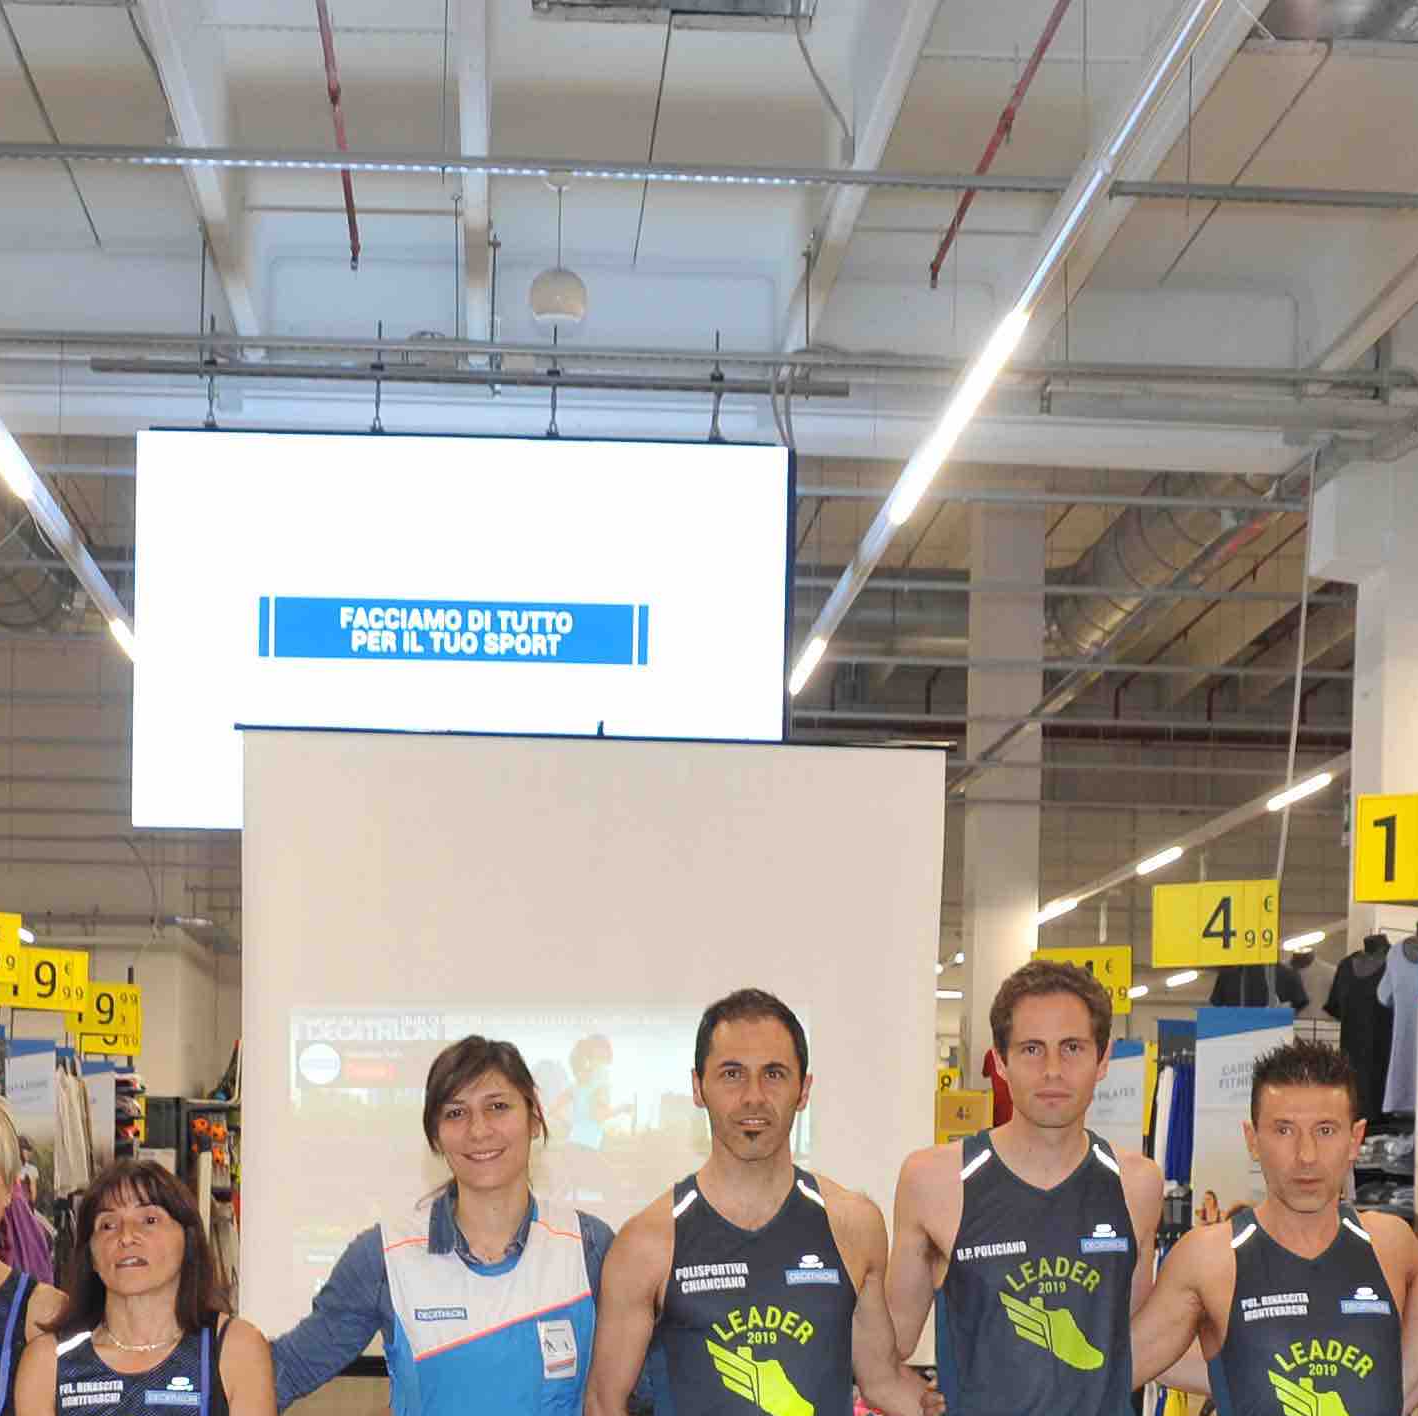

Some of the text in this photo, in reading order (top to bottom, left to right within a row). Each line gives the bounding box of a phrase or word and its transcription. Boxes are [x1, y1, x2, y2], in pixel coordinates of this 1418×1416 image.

[340, 607, 573, 634] FACCIAMO DI TUTTO
[351, 631, 562, 656] PER IL TUO SPORT
[1201, 896, 1237, 950] 4
[1244, 928, 1274, 948] 99
[974, 1241, 1027, 1257] POLICIANO
[675, 1263, 749, 1281] POLISPORTIVA
[1005, 1257, 1101, 1293] LEADER
[681, 1276, 747, 1294] CHIANCIANO
[1038, 1280, 1067, 1295] 2019
[712, 1305, 815, 1345] LEADER
[746, 1332, 777, 1346] 2019
[1273, 1338, 1374, 1378] LEADER
[1308, 1362, 1337, 1377] 2019
